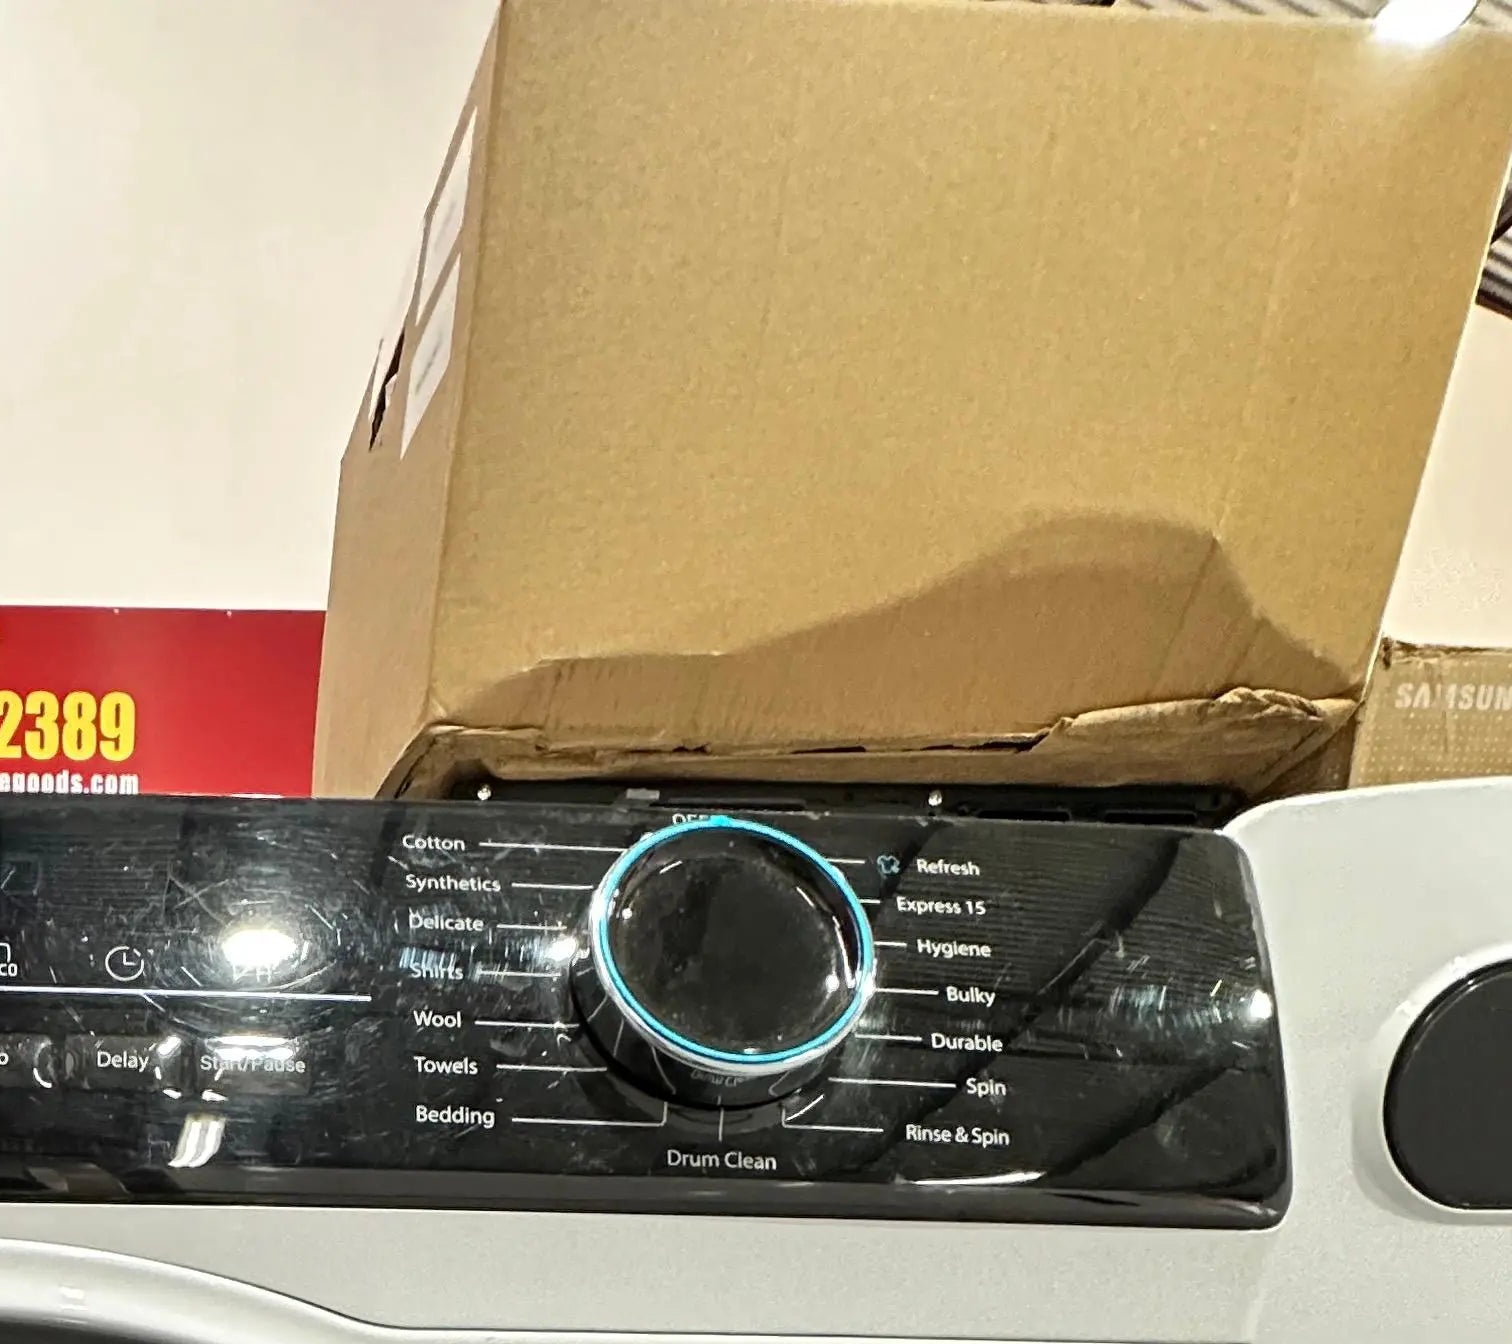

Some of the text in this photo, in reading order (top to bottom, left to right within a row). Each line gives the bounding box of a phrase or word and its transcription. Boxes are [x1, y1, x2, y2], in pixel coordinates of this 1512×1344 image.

[402, 834, 465, 851] Cotton
[916, 858, 980, 876] Refresh
[405, 874, 501, 893] Synthetics
[896, 896, 986, 915] Express 15
[408, 912, 484, 932] Delicate
[916, 939, 991, 959] Hygiene
[946, 986, 996, 1007] Bulky
[413, 1010, 461, 1028] Wool
[931, 1033, 1003, 1052] Durable
[97, 1051, 149, 1073] Delay
[413, 1055, 478, 1075] Towels
[966, 1077, 1006, 1097] Spin
[415, 1105, 496, 1128] Bedding
[906, 1124, 1010, 1148] Rinse & Spin
[666, 1149, 777, 1171] Drum Clean
